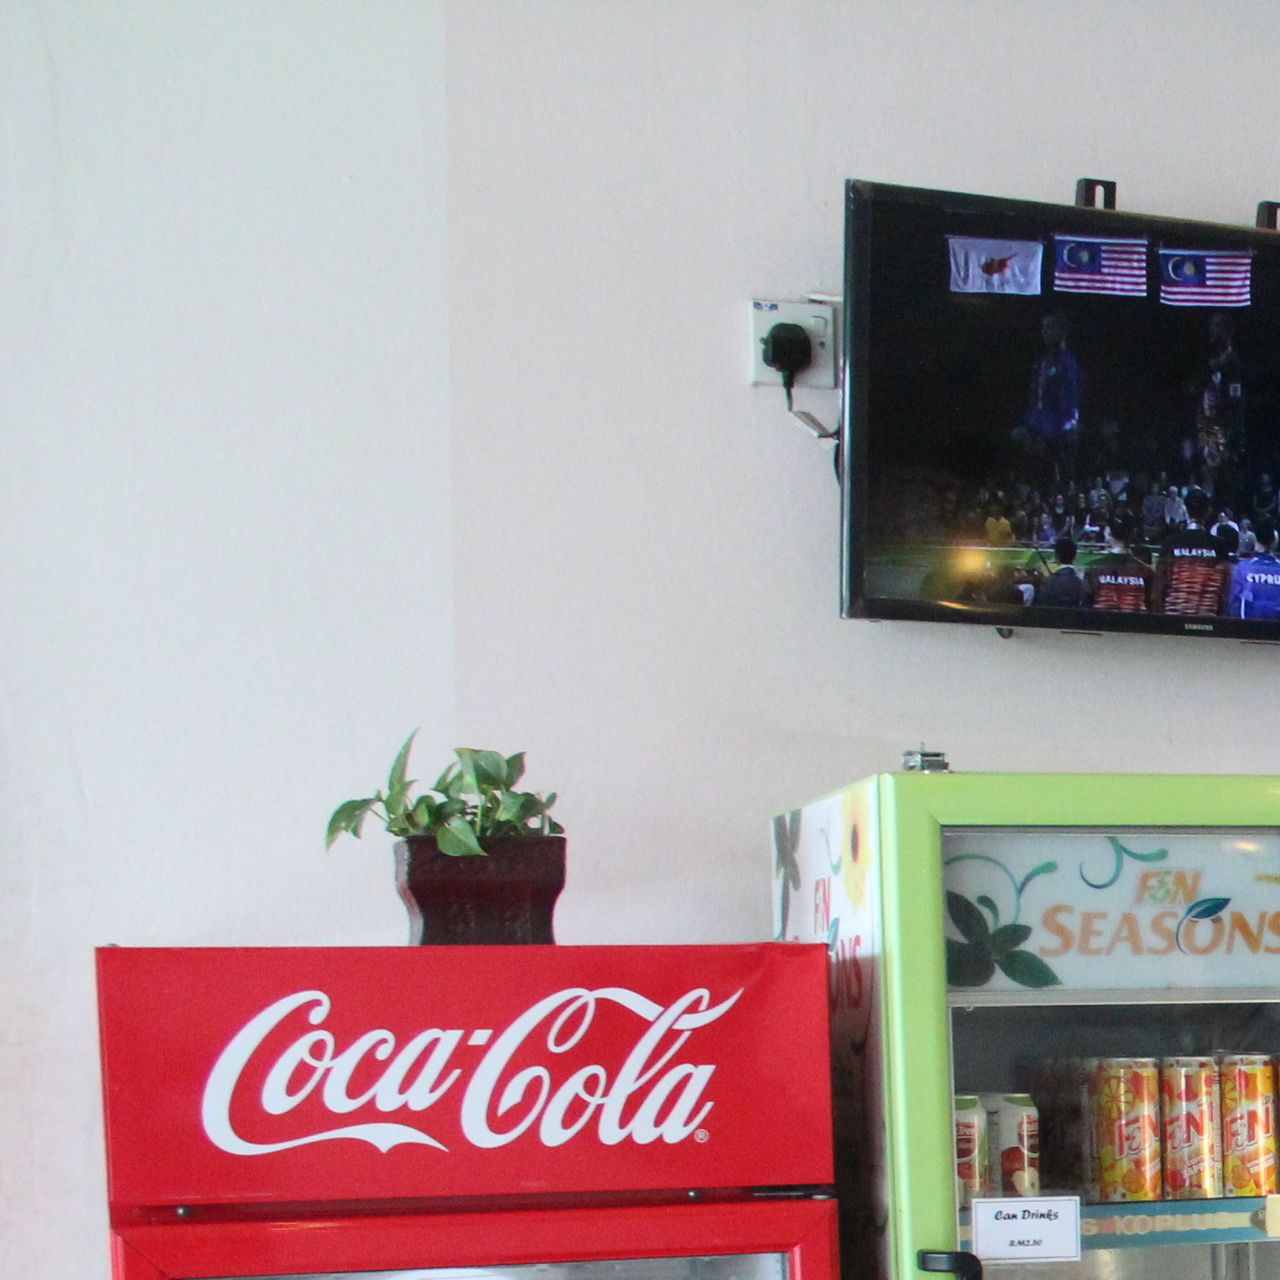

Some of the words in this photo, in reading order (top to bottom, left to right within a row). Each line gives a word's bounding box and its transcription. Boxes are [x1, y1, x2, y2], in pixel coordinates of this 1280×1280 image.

[200, 986, 744, 1156] Coca-Cola
[995, 1210, 1019, 1221] Can
[1021, 1209, 1059, 1222] Drinks
